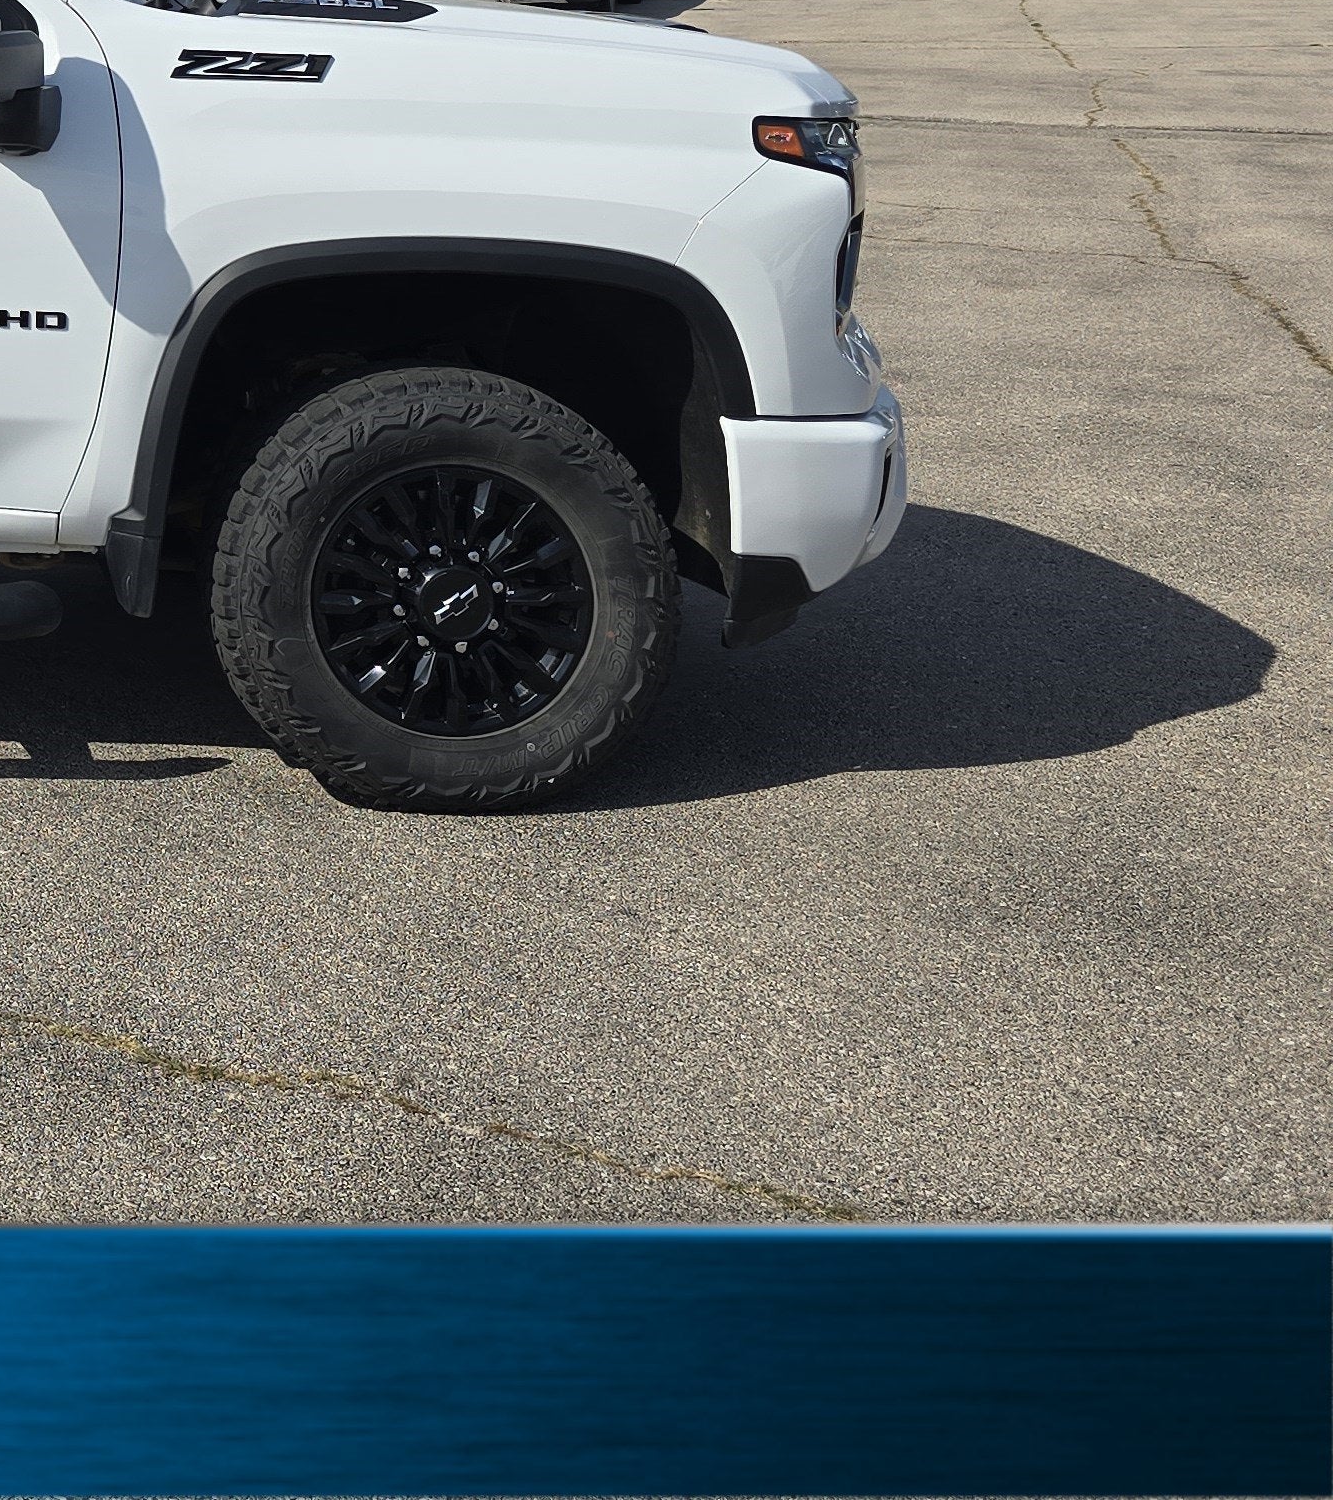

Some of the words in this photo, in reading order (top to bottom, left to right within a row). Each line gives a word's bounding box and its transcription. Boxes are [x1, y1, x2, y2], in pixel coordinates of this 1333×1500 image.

[170, 49, 335, 83] Z71
[608, 575, 637, 682] TRAC
[540, 685, 611, 760] GRIP
[451, 749, 528, 778] M/T
